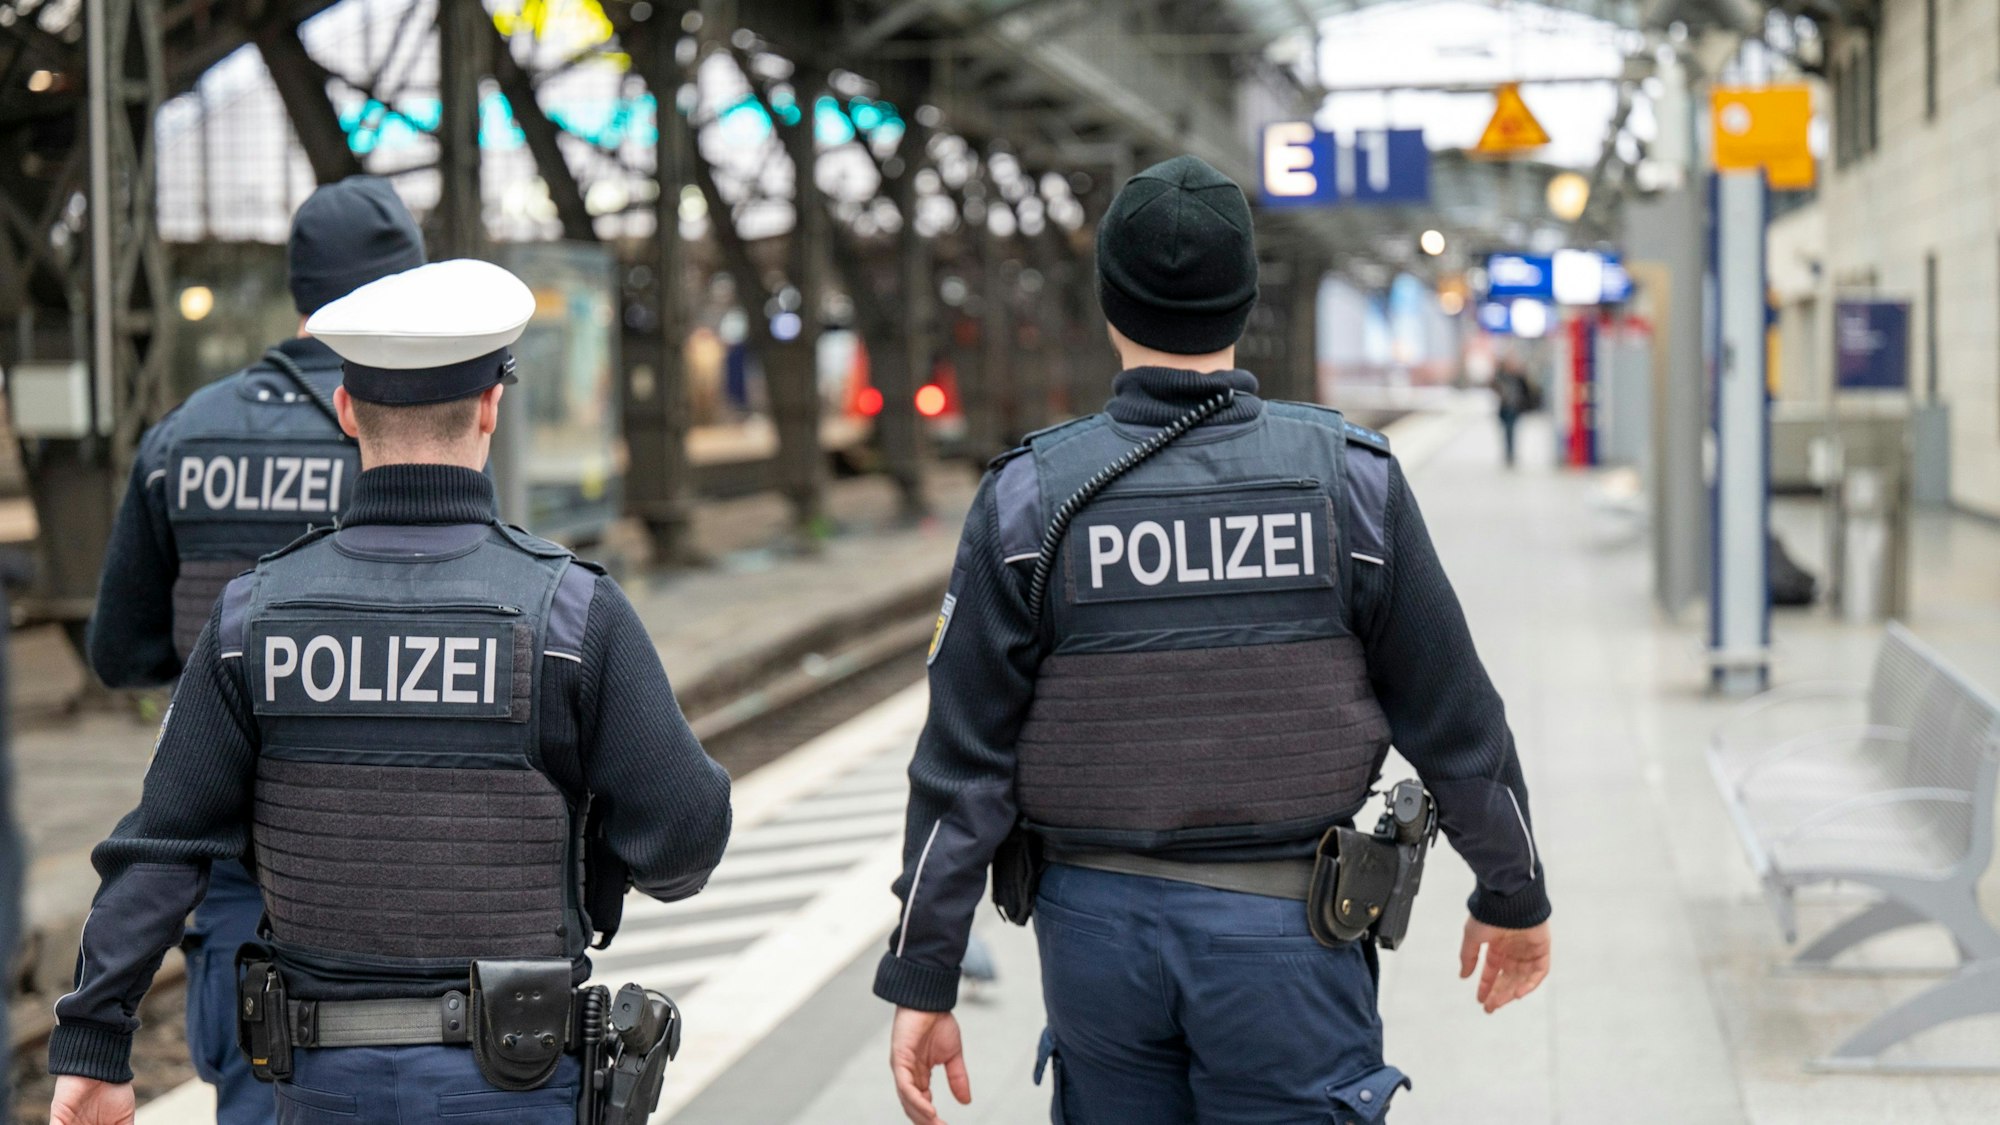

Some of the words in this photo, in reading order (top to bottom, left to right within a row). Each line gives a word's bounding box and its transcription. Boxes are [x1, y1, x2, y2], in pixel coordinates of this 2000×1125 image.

[1264, 121, 1317, 196] E
[178, 455, 344, 512] POLIZEI
[1088, 511, 1315, 589] POLIZEI
[264, 634, 497, 704] POLIZEI
